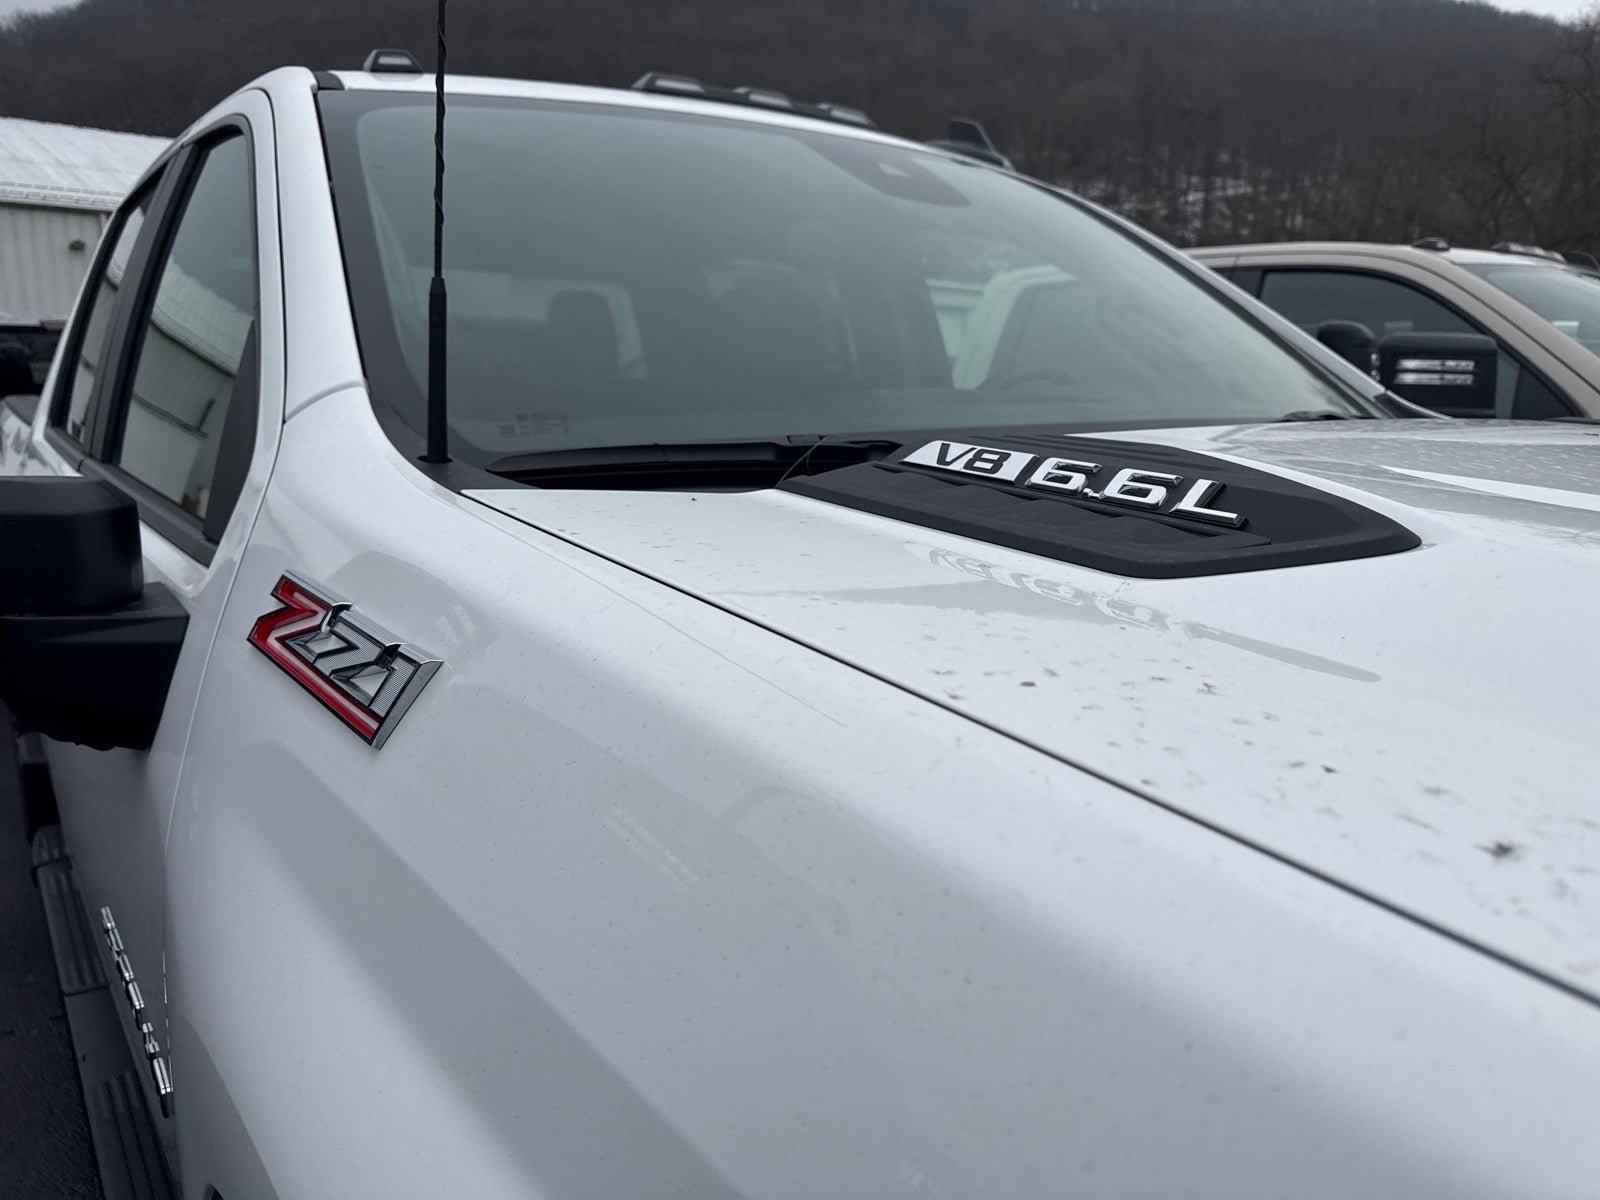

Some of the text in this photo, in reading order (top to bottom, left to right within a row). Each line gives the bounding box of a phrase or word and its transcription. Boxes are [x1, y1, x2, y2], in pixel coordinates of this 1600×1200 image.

[932, 441, 1247, 529] V8 6.6L
[247, 569, 444, 750] Z71
